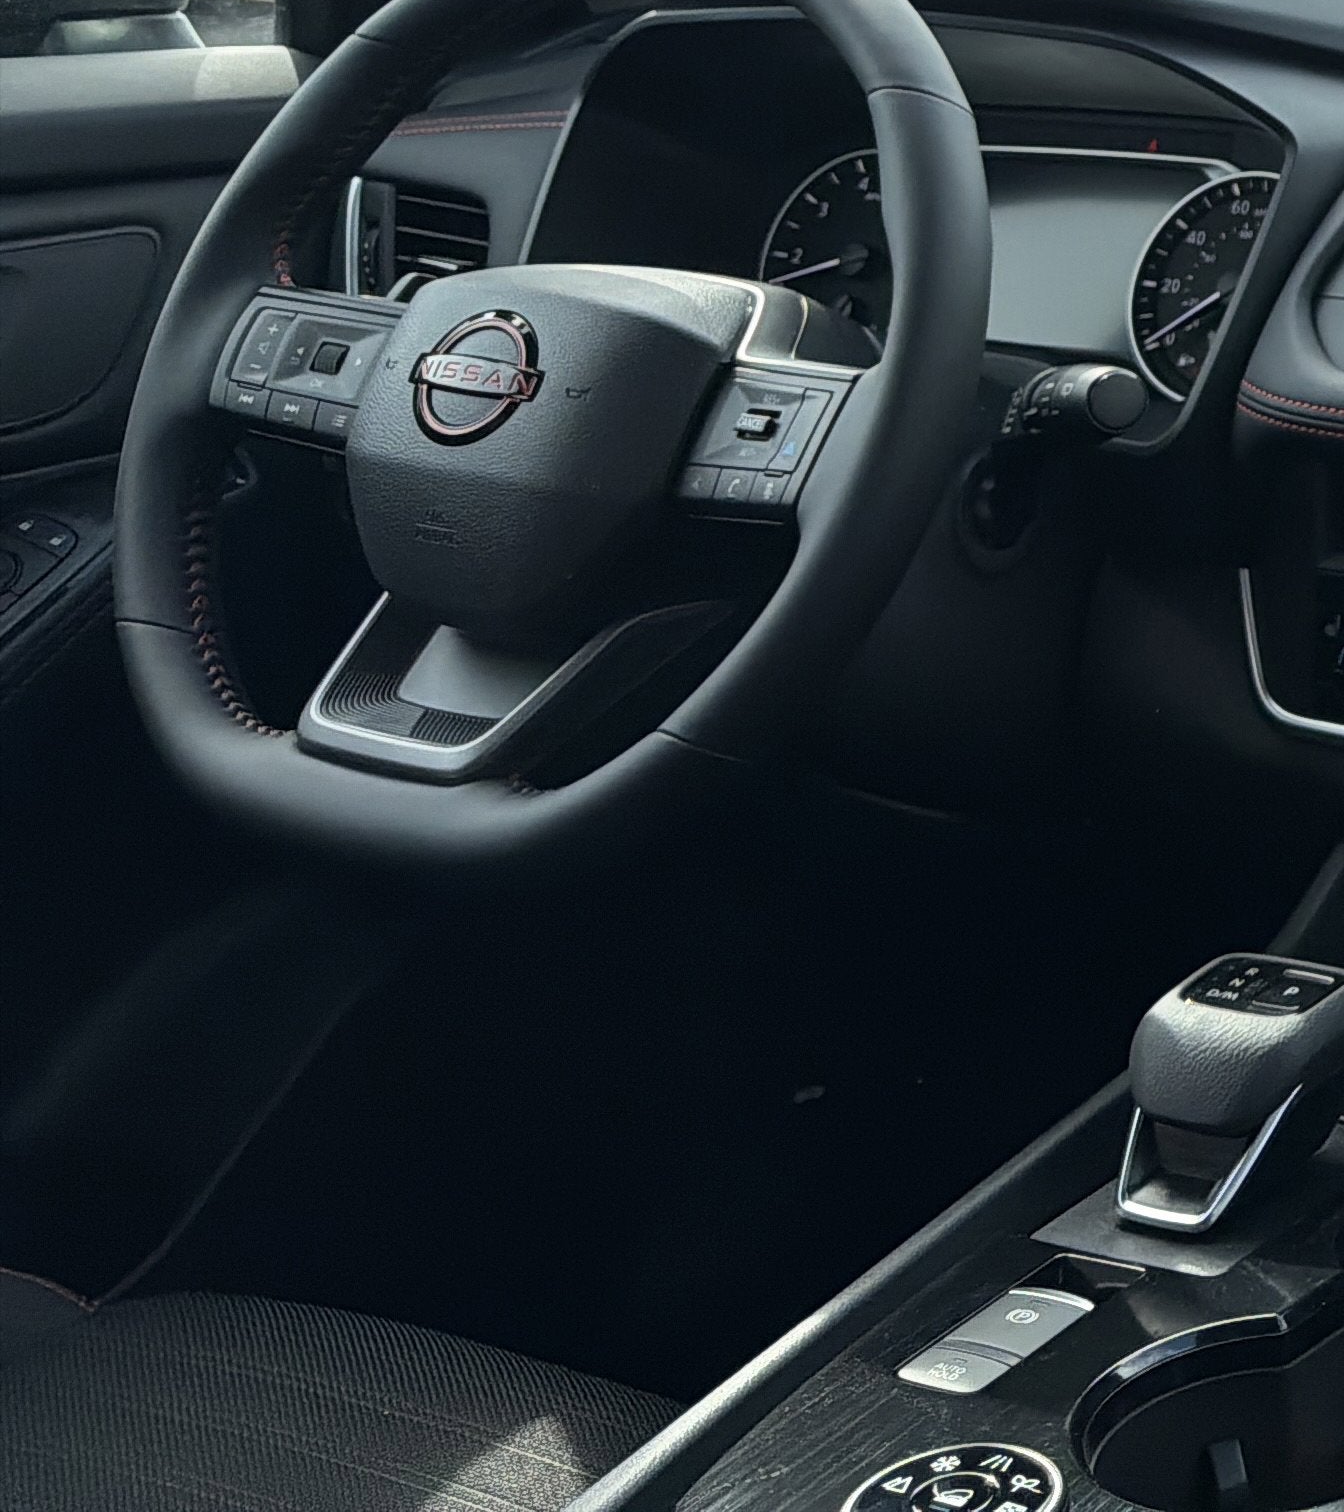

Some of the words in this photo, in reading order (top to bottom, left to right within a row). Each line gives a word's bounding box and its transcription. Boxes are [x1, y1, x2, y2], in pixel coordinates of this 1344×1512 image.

[1231, 200, 1251, 214] 60
[1187, 231, 1207, 245] 40
[1160, 278, 1181, 294] 20
[418, 356, 538, 396] NISSAN
[1282, 985, 1300, 996] P
[927, 1369, 960, 1381] HOLD
[934, 1362, 966, 1375] AUTO
